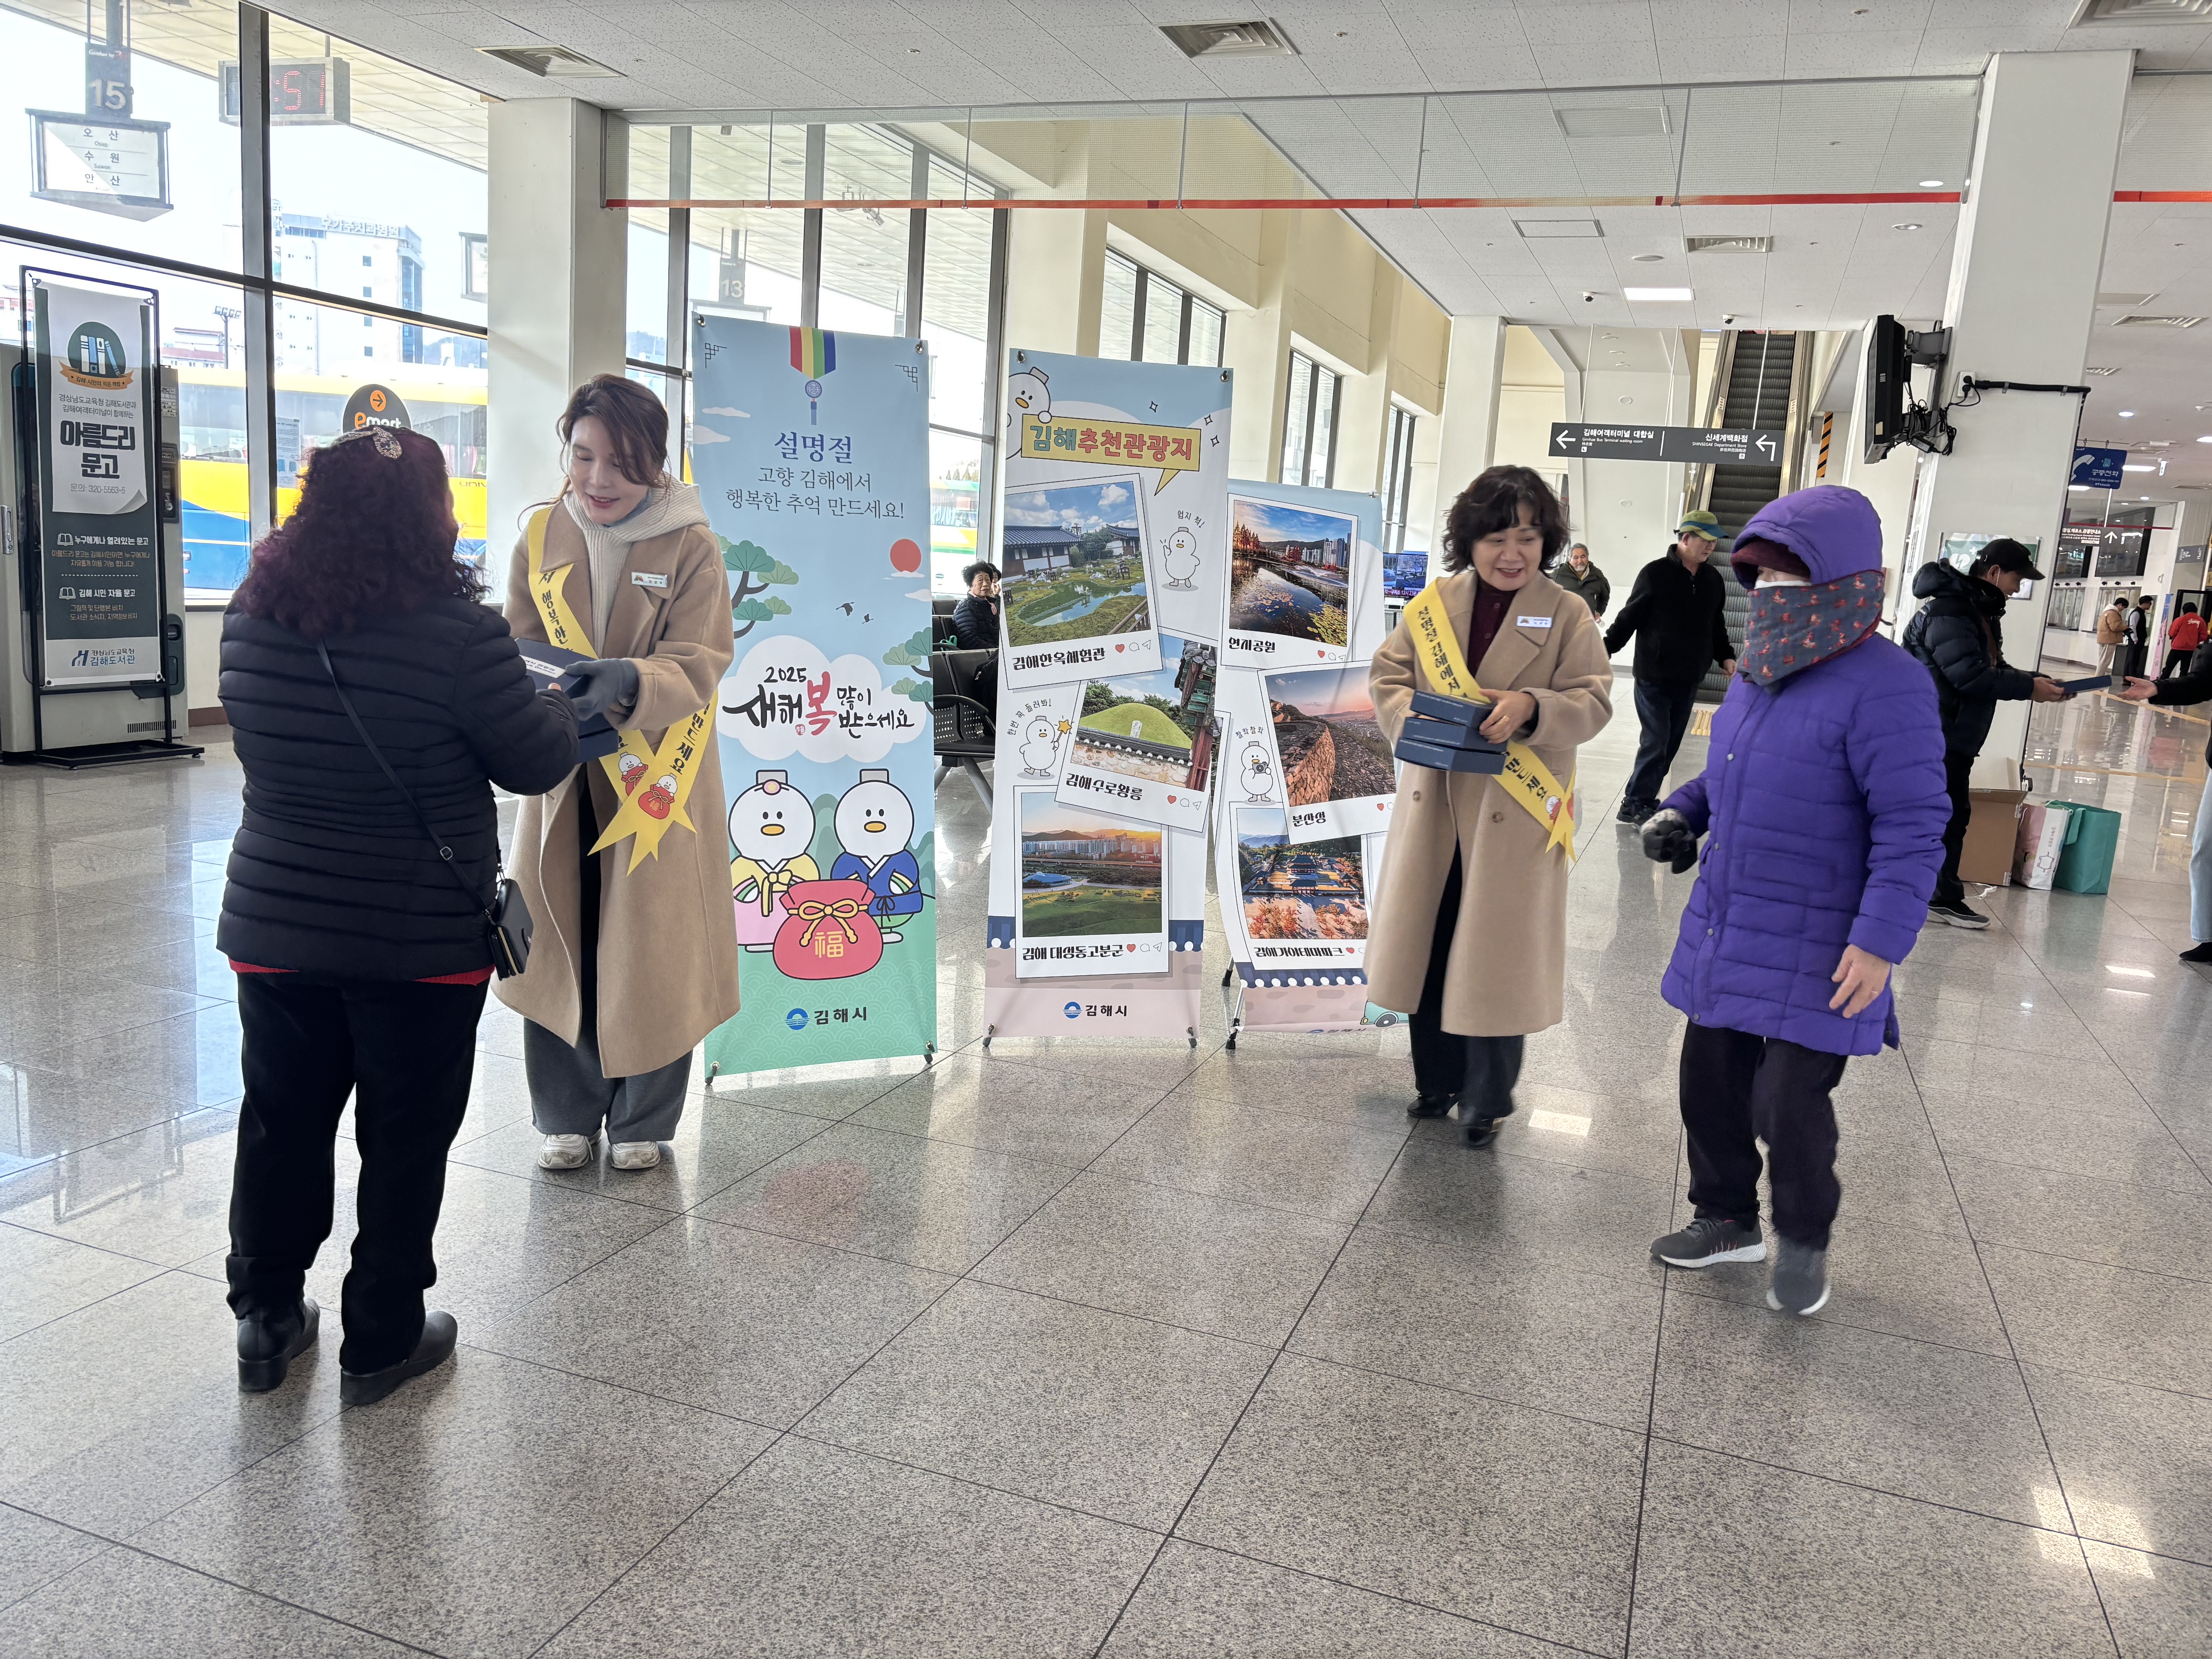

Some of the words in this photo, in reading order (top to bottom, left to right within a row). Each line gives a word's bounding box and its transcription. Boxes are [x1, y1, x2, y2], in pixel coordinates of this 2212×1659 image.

[89, 79, 126, 109] 15
[721, 279, 743, 298] 13
[59, 394, 104, 406] 경상남도교육청
[105, 399, 136, 409] 김해도서관과
[62, 405, 112, 417] 김해여객터미널이
[114, 410, 134, 419] 함께하는
[60, 420, 136, 450] 아름드리
[1583, 429, 1630, 438] 김해여객터미널
[1633, 430, 1654, 438] 대합실
[1705, 433, 1748, 443] 신세계백화점
[774, 431, 853, 464] 설명절
[81, 452, 120, 479] 문고
[71, 483, 87, 492] 문의:
[758, 467, 794, 487] 고향
[800, 469, 872, 493] 김해에서
[726, 488, 781, 512] 행복한
[786, 493, 821, 515] 추억
[827, 496, 905, 519] 만드세요!
[1177, 510, 1191, 520] 엄지
[75, 536, 105, 544] 누구에게나
[107, 536, 135, 545] 열려있는
[79, 589, 92, 598] 김해
[94, 589, 106, 598] 시민
[124, 589, 135, 598] 문고
[541, 590, 568, 644] 행복한
[1228, 636, 1276, 654] 연지공원
[1417, 606, 1439, 642] 설명절
[1429, 641, 1461, 694] 김해에서
[90, 654, 136, 666] 김해도서관
[1013, 647, 1106, 671] 김해한옥체험관
[763, 666, 807, 684] 2025
[722, 684, 803, 728] 새해
[805, 671, 838, 736] 복
[837, 685, 872, 711] 많이
[839, 708, 915, 739] 받으세요
[669, 713, 704, 775] 만드세요
[1065, 773, 1143, 801] 김해수로왕릉
[1505, 757, 1548, 802] 만드세요
[1292, 811, 1327, 827] 분산성
[814, 930, 844, 958] 福
[1022, 946, 1047, 961] 김해
[1050, 944, 1124, 960] 대성동고분군
[1253, 947, 1345, 957] 김해가야테마파크
[814, 1006, 867, 1025] 김해시
[1085, 1005, 1128, 1017] 김해시
